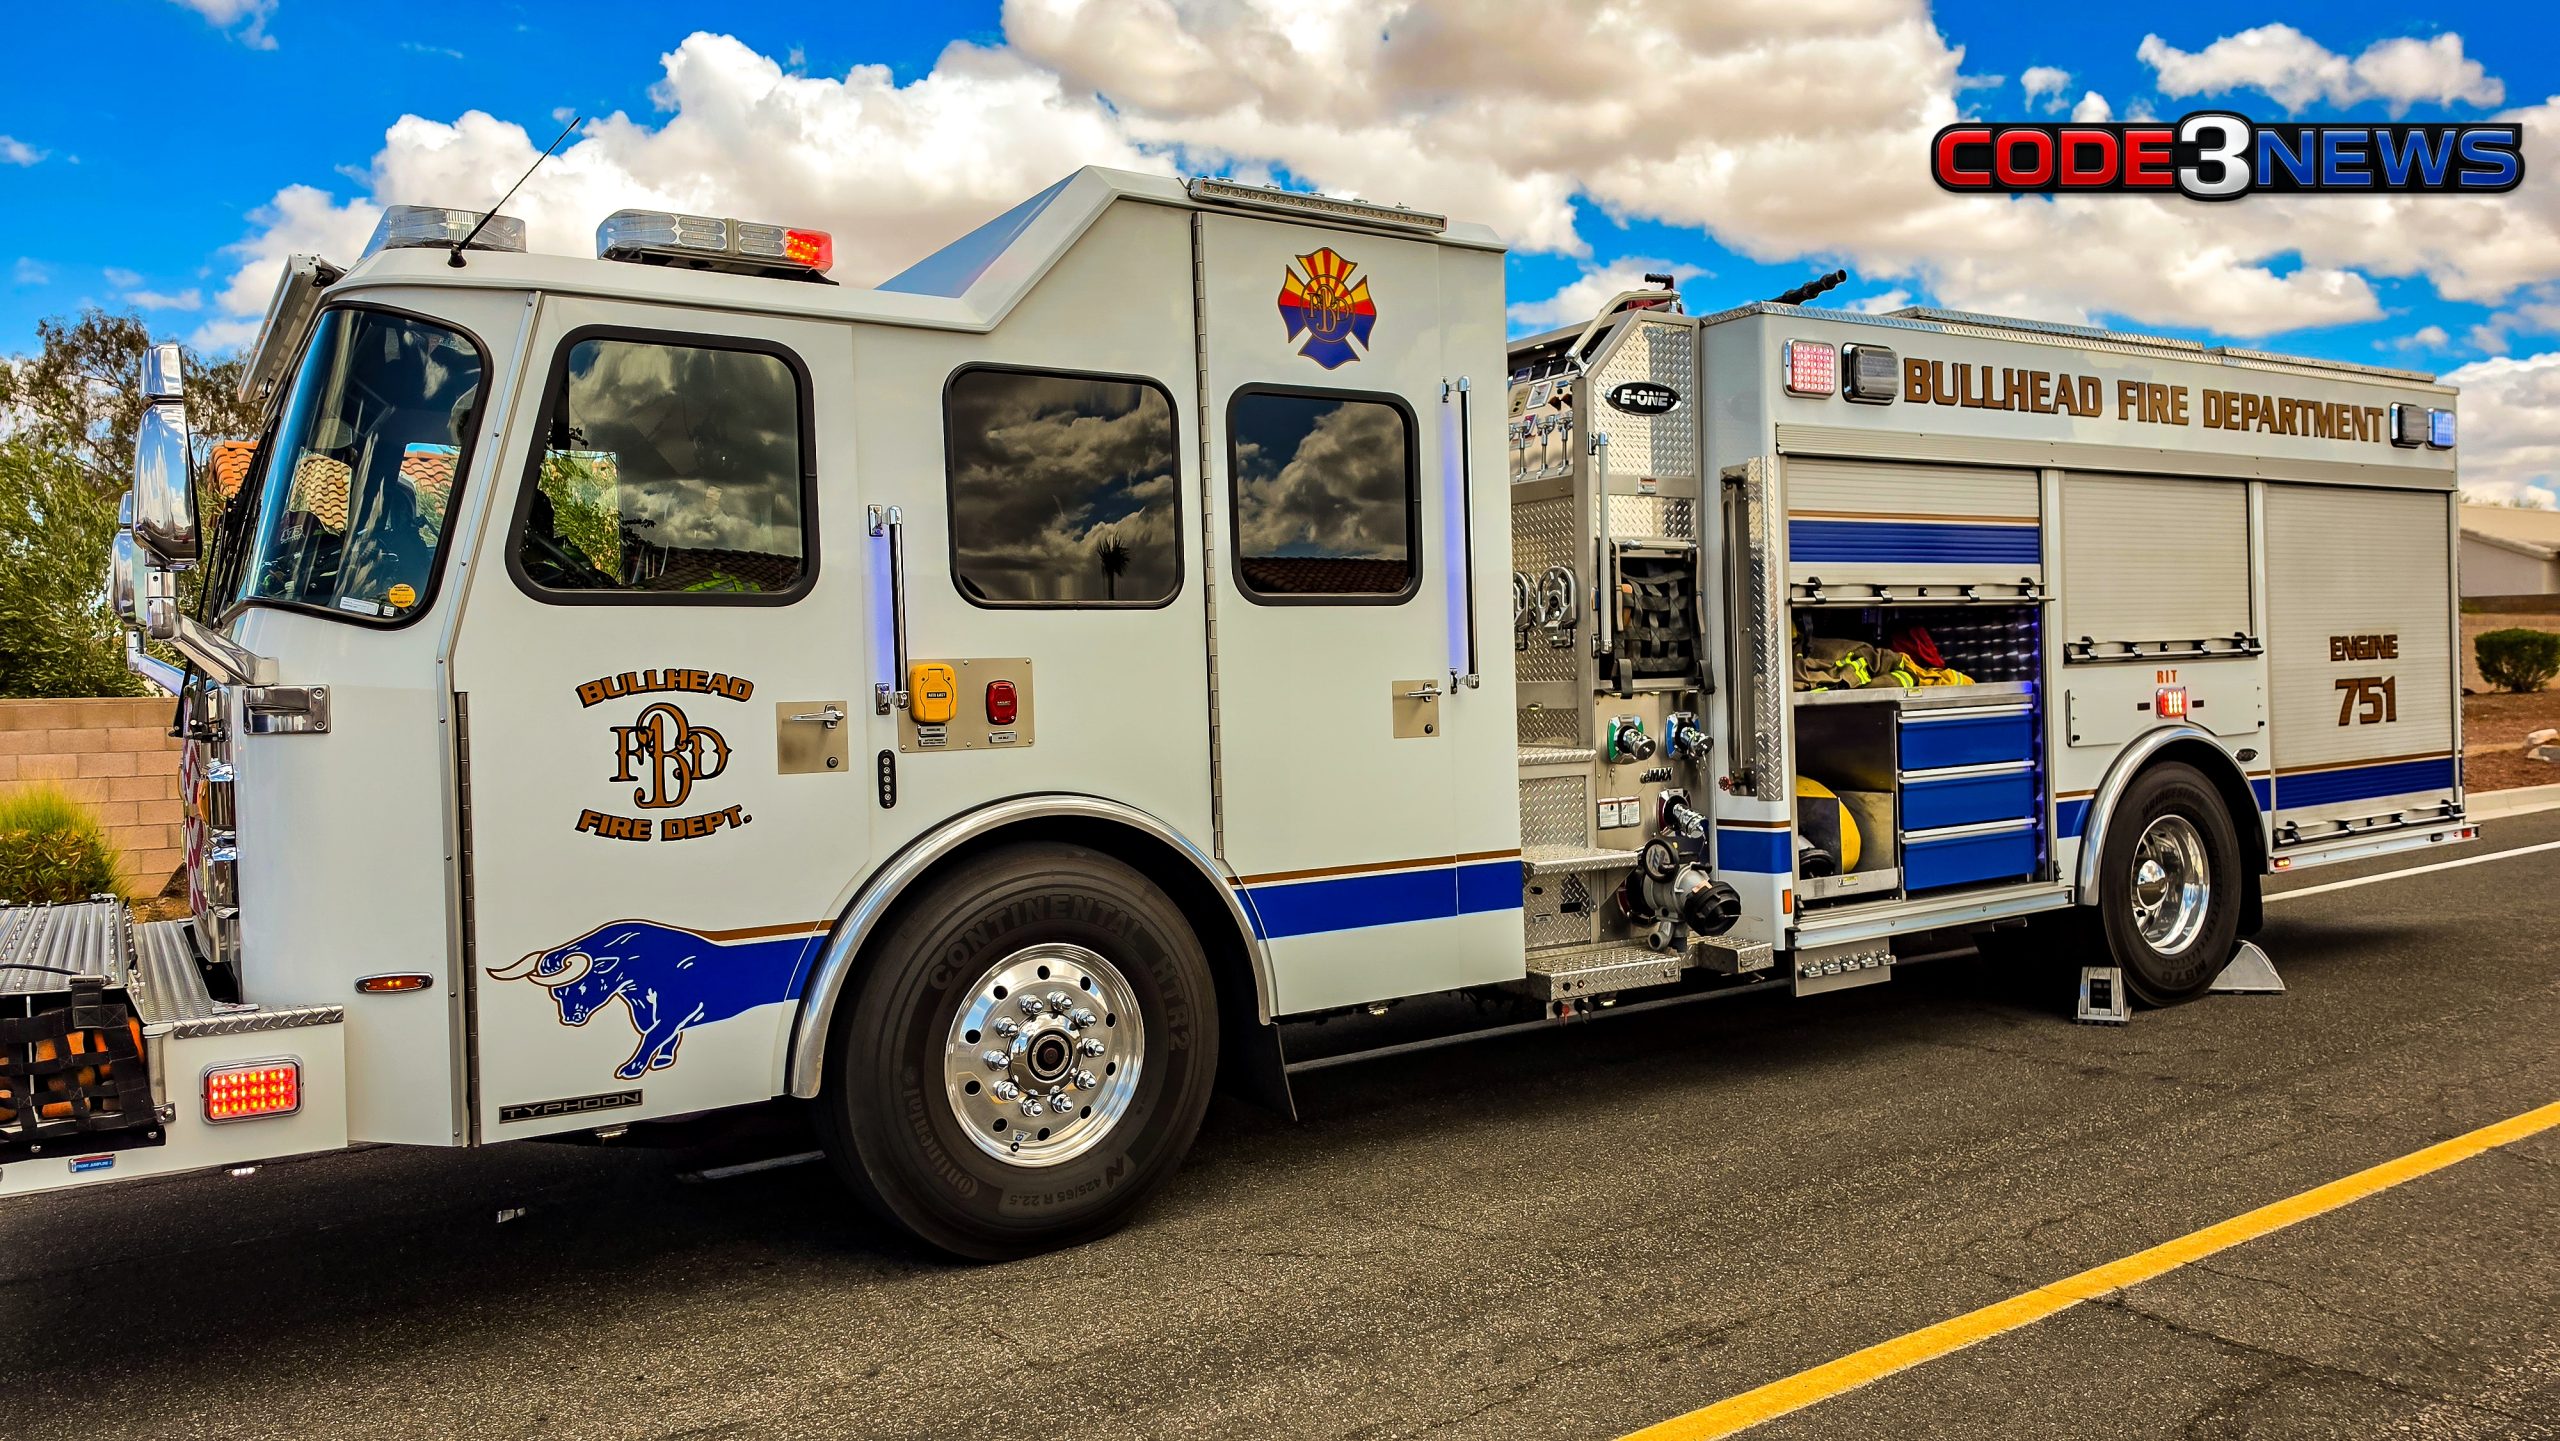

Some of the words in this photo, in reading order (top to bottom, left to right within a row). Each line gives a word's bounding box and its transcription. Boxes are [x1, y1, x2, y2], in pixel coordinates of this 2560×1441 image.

[1620, 388, 1669, 406] E-ONE
[1903, 357, 2103, 418] BULLHEAD
[2117, 379, 2190, 426] FIRE
[2202, 389, 2384, 443] DEPARTMENT
[2329, 634, 2399, 661] ENGINE
[575, 669, 755, 708] BULLHEAD
[2156, 669, 2177, 684] RIT
[2335, 675, 2397, 727] 751
[575, 808, 652, 842] FIRE
[660, 804, 753, 842] DEPT.
[929, 894, 1144, 991] CONTINENTAL
[1151, 953, 1192, 1051] HTR2
[502, 1092, 639, 1118] TYPHOON
[1008, 1194, 1040, 1207] 22.5
[1043, 1193, 1054, 1205] R
[1057, 1179, 1101, 1202] 425/65
